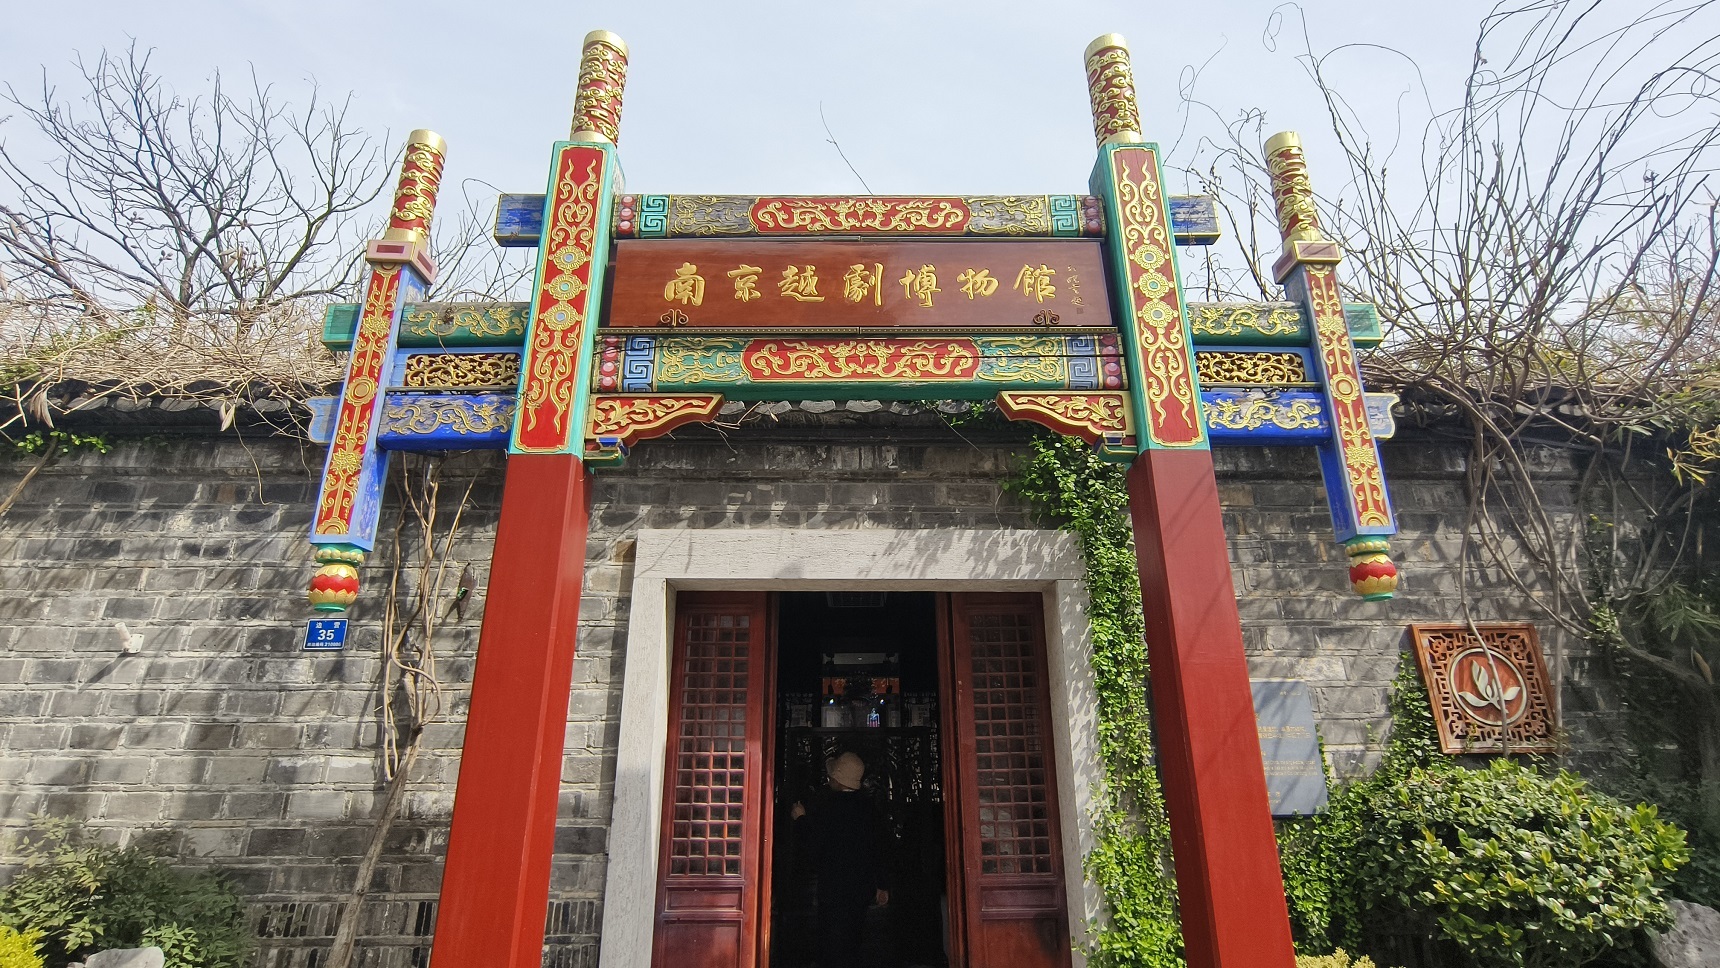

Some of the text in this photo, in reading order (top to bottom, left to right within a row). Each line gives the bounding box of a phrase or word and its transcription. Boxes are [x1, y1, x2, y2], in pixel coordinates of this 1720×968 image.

[664, 262, 1056, 307] 南京越劇博物館
[317, 630, 335, 640] 35
